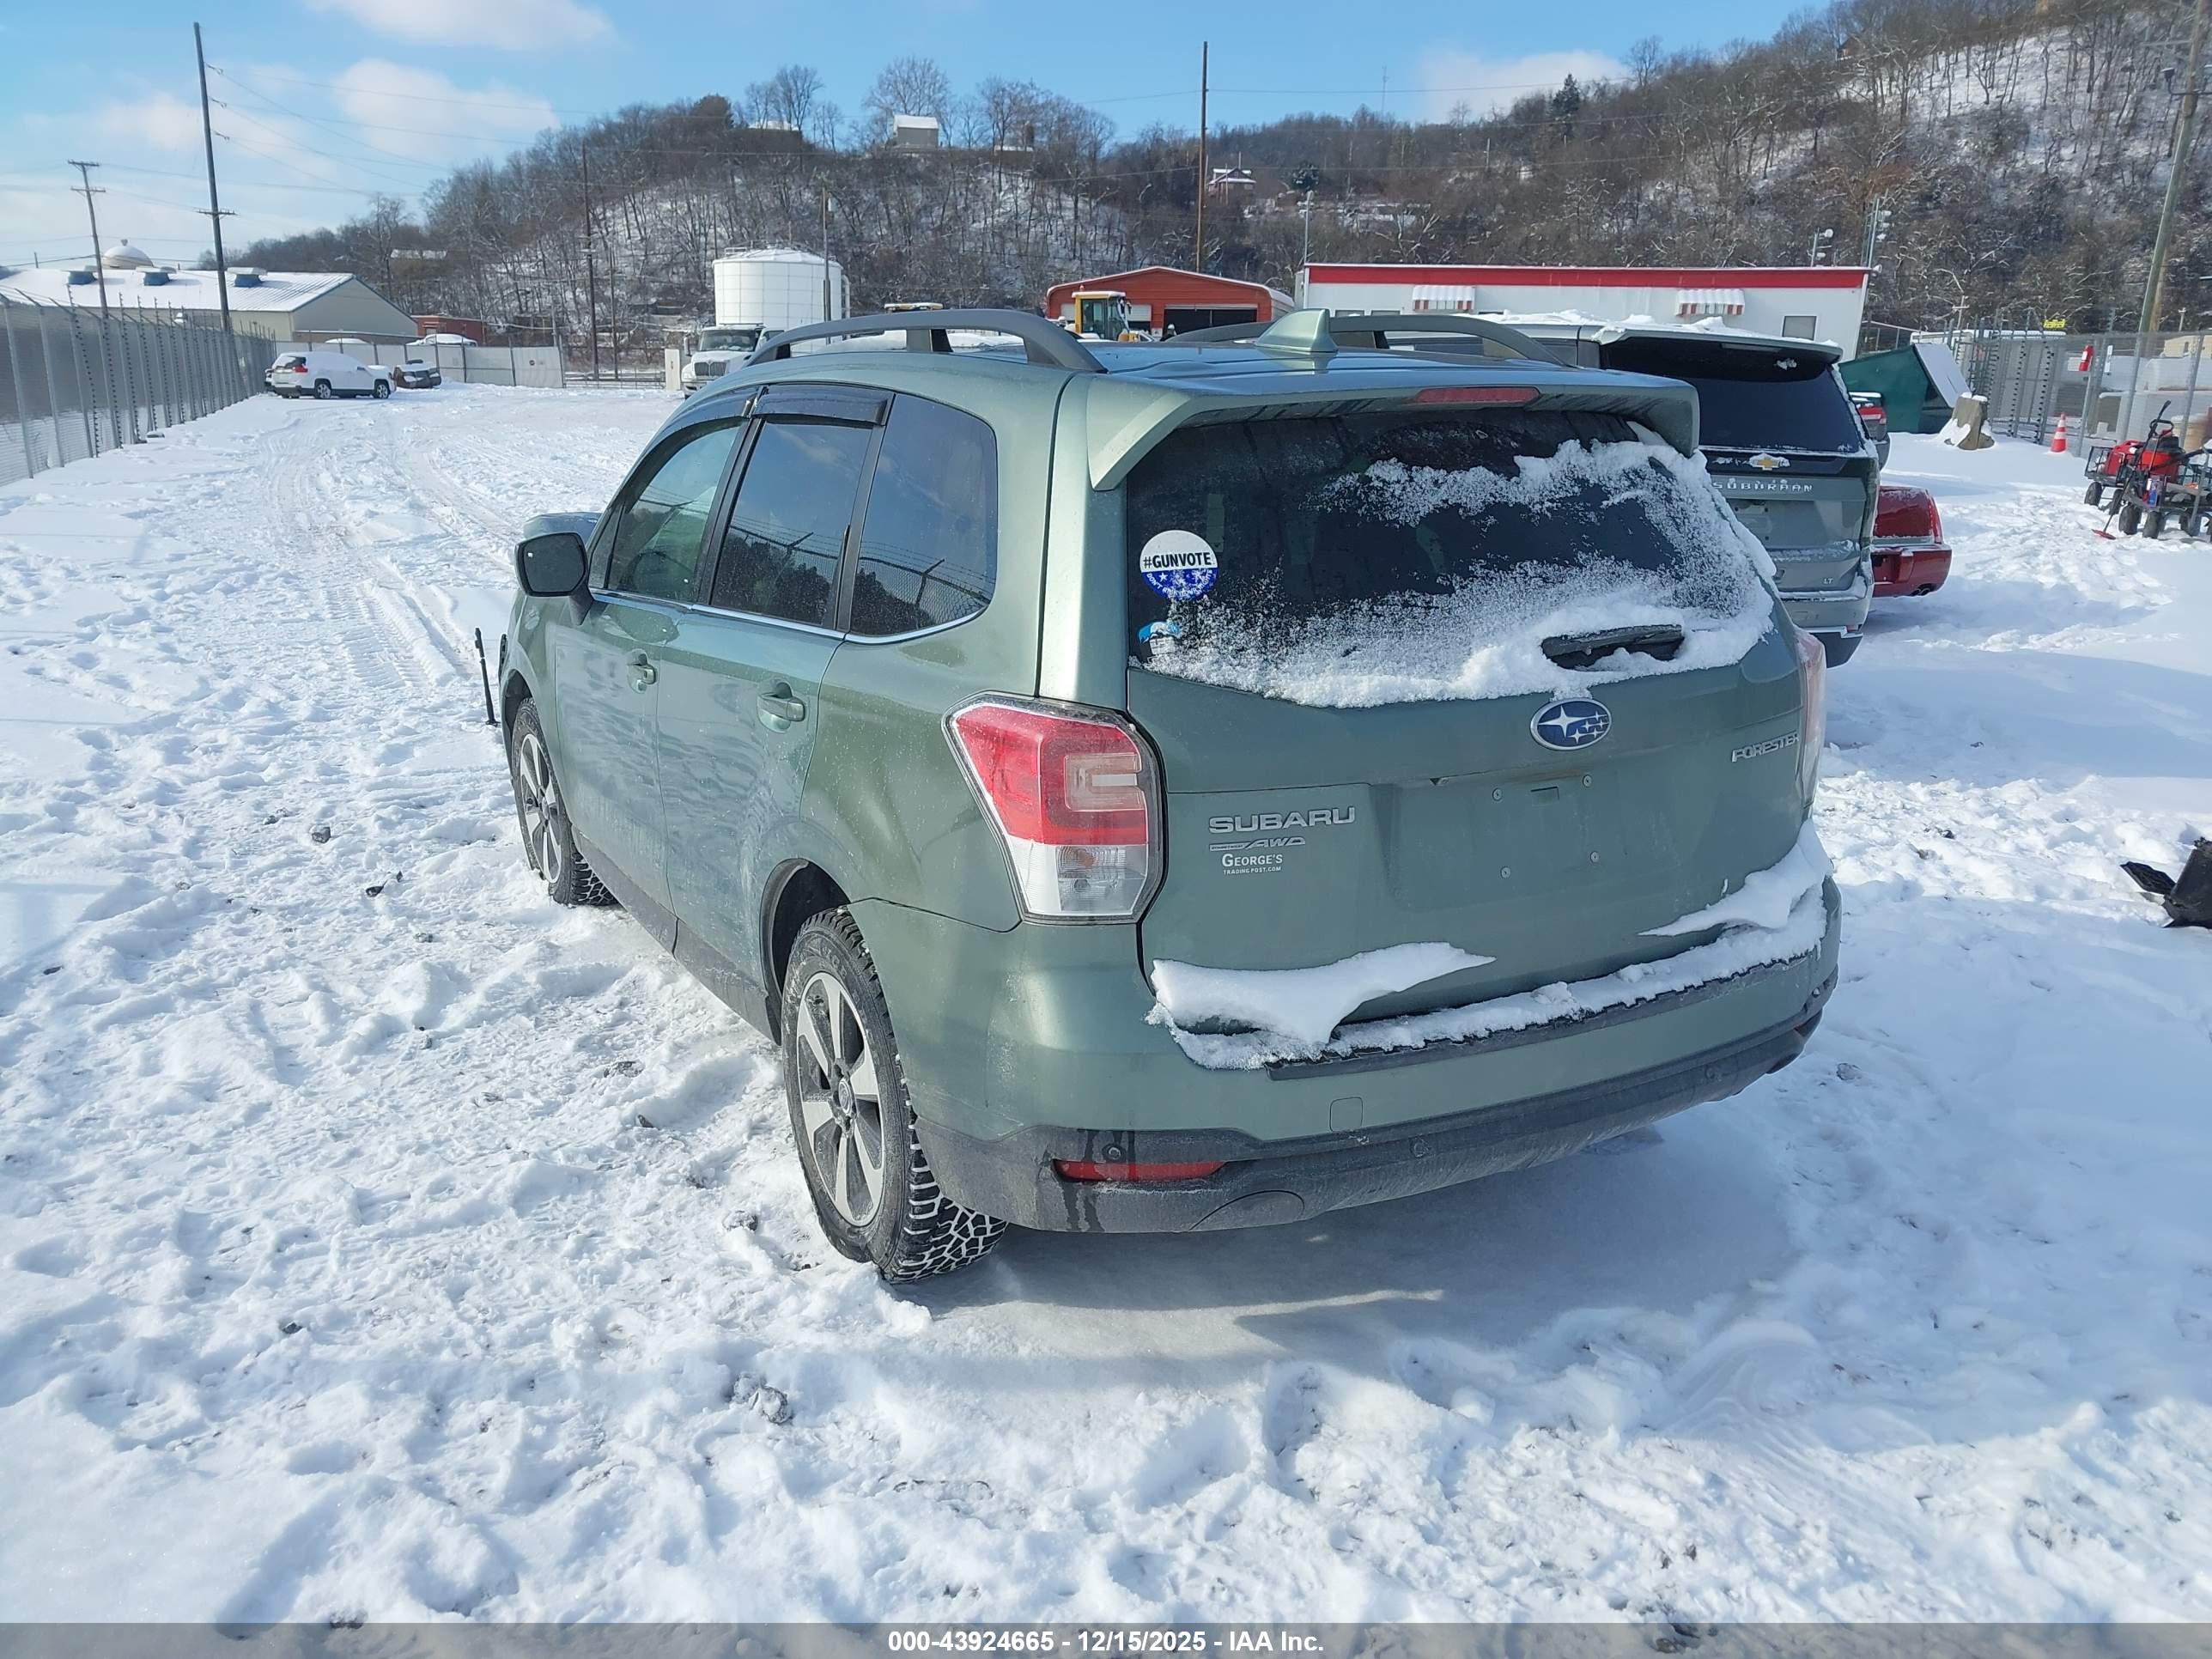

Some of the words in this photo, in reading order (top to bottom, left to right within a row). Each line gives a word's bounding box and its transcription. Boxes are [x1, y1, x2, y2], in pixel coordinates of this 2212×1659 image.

[1711, 481, 1813, 492] SUBURBAN
[1143, 552, 1212, 568] #GUNVOTE
[1731, 731, 1800, 763] FORESTER
[1208, 806, 1356, 834] SUBARU
[1245, 836, 1306, 850] AWD
[1221, 853, 1284, 867] GEORGE'S
